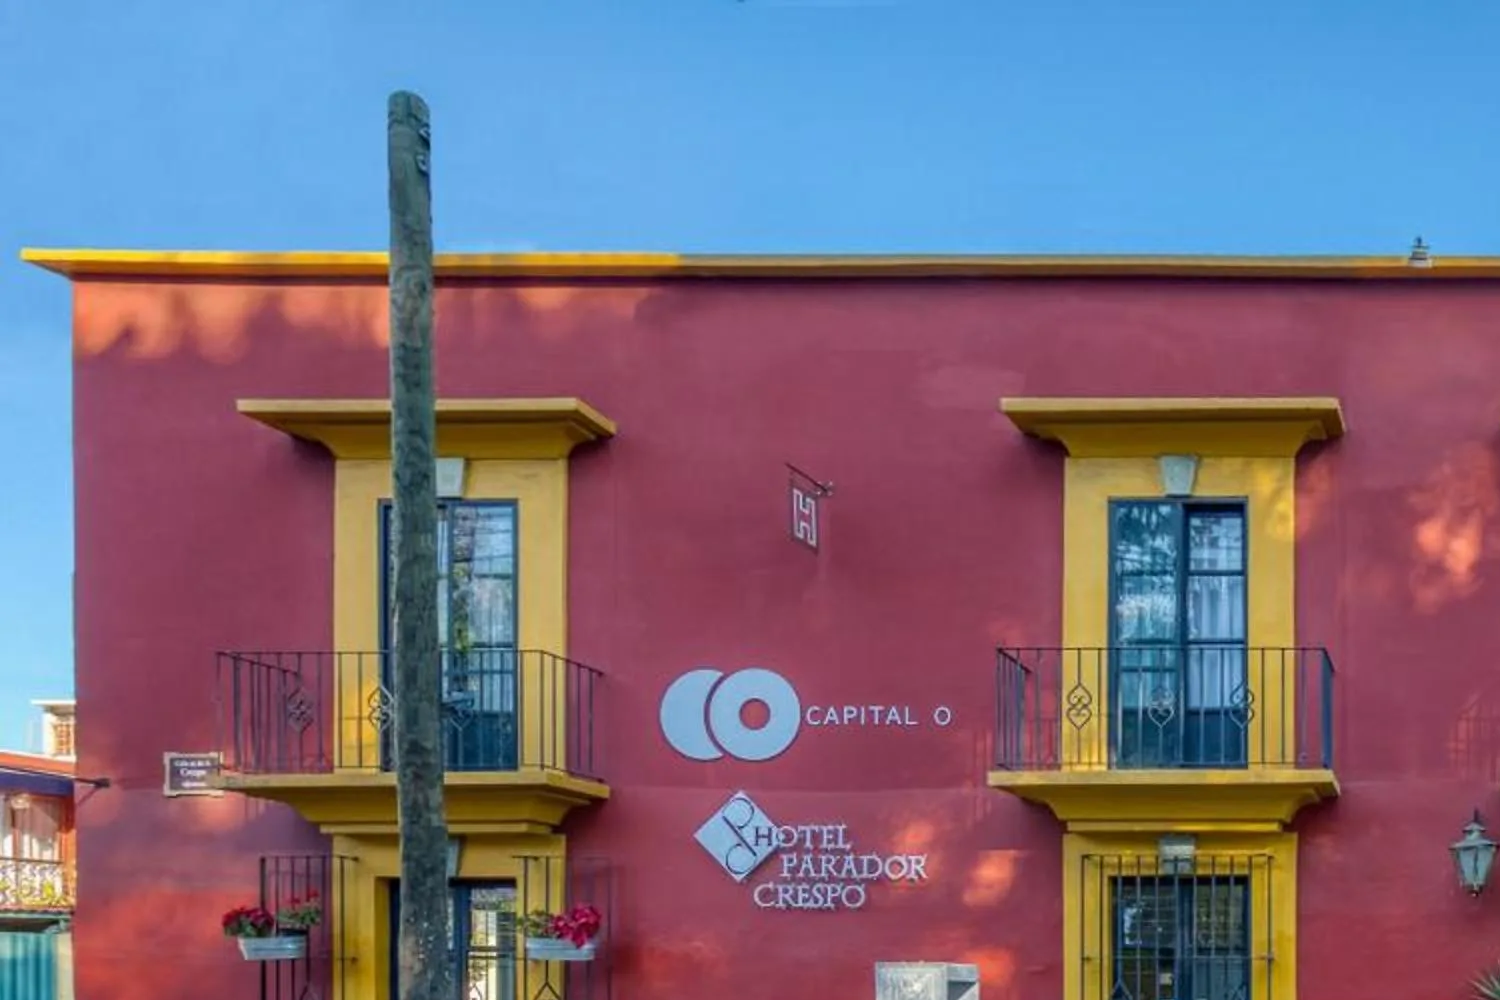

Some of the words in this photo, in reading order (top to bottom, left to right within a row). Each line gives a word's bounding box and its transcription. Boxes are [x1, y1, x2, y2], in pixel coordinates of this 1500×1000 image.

[805, 706, 919, 726] CAPITAL
[933, 706, 951, 726] O
[754, 825, 852, 850] HOTEL
[779, 853, 928, 881] PARADOR
[753, 882, 866, 909] CRESPO
